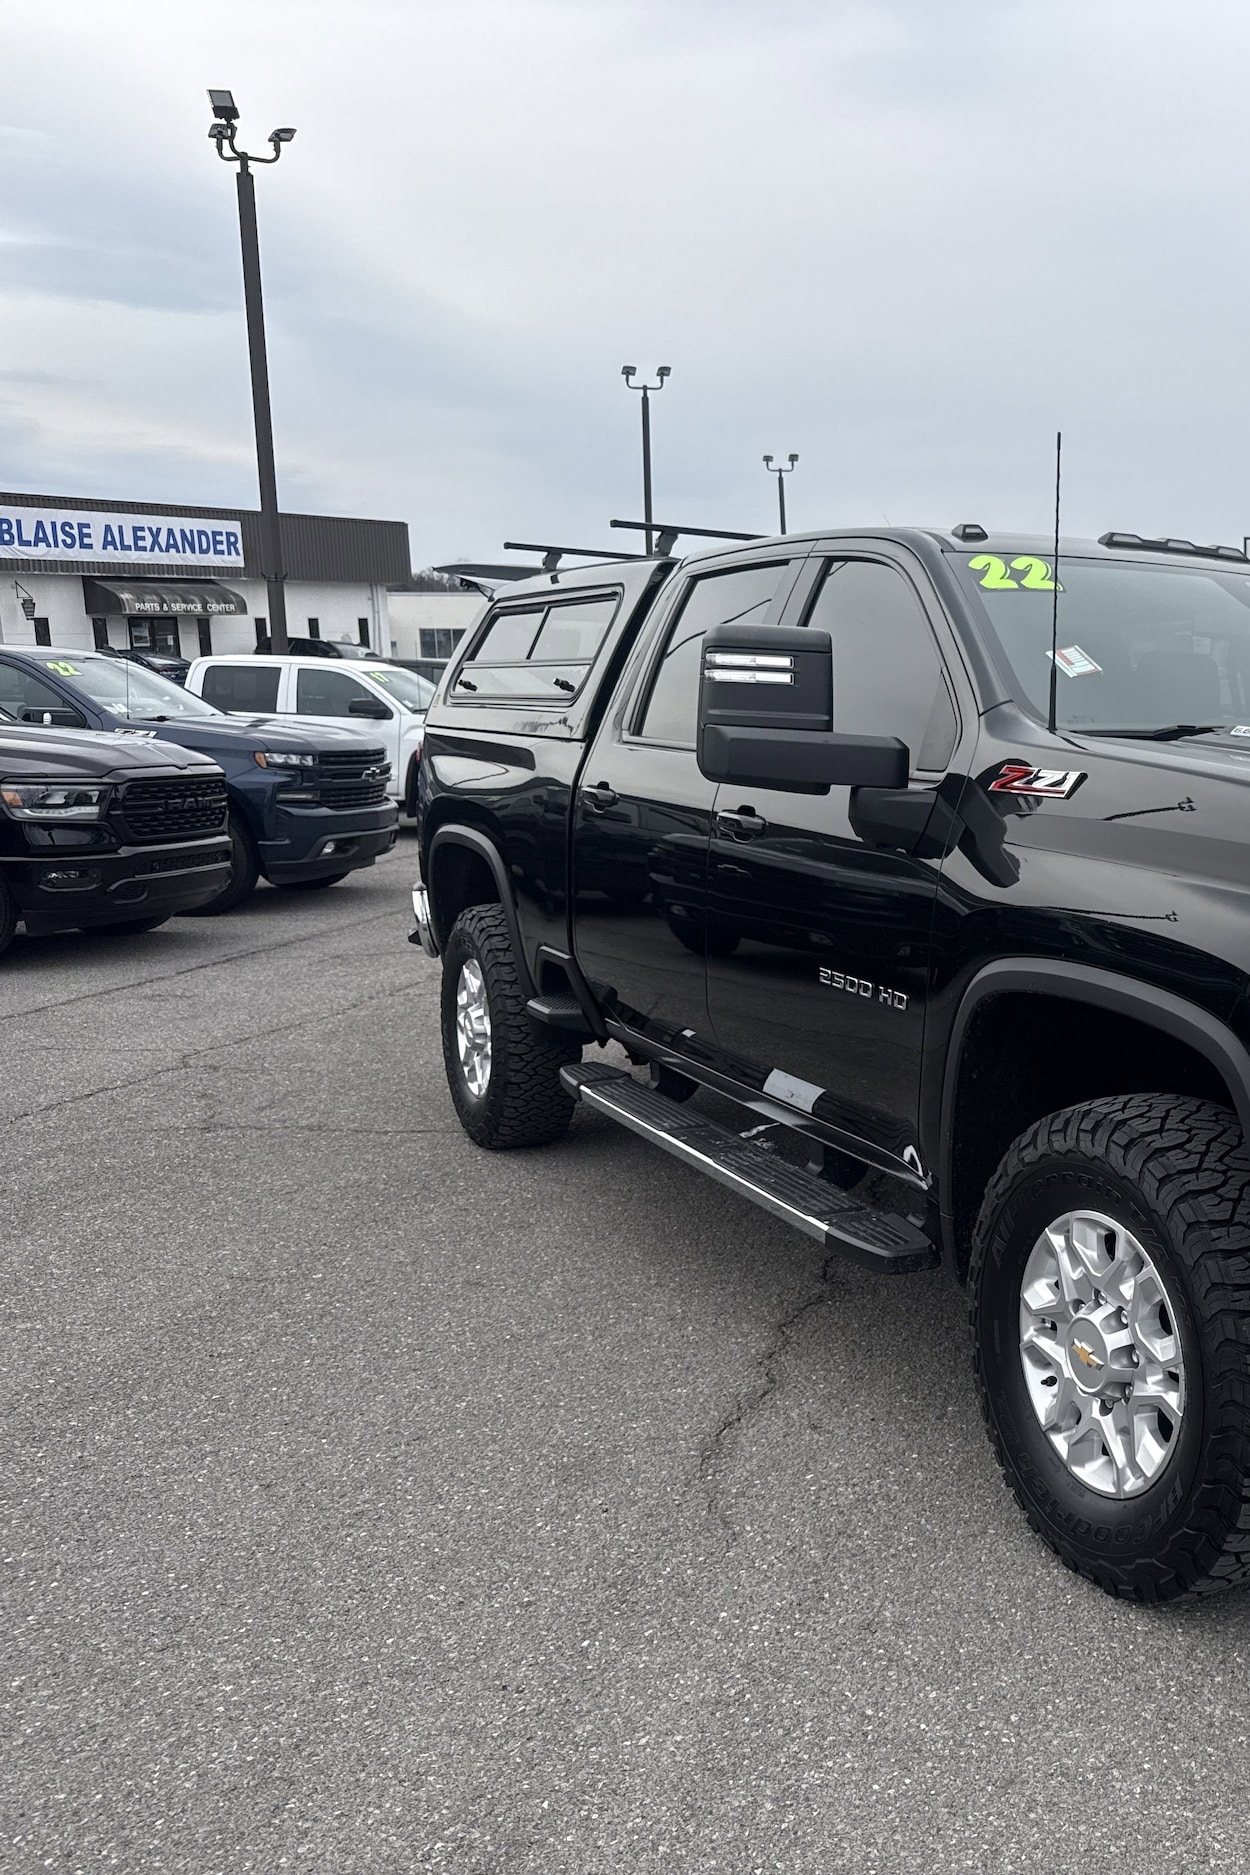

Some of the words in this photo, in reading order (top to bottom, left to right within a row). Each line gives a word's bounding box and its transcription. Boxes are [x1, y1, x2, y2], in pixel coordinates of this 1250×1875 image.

[0, 518, 93, 550] BLAISE
[102, 523, 241, 557] ALEXANDER
[968, 554, 1064, 591] 22
[135, 602, 160, 612] PARTS
[162, 602, 169, 612] &
[171, 602, 202, 612] SERVICE
[207, 603, 236, 612] CENTER
[46, 661, 82, 677] 22
[988, 765, 1087, 800] Z71
[819, 966, 873, 998] 2500
[879, 986, 908, 1011] HD
